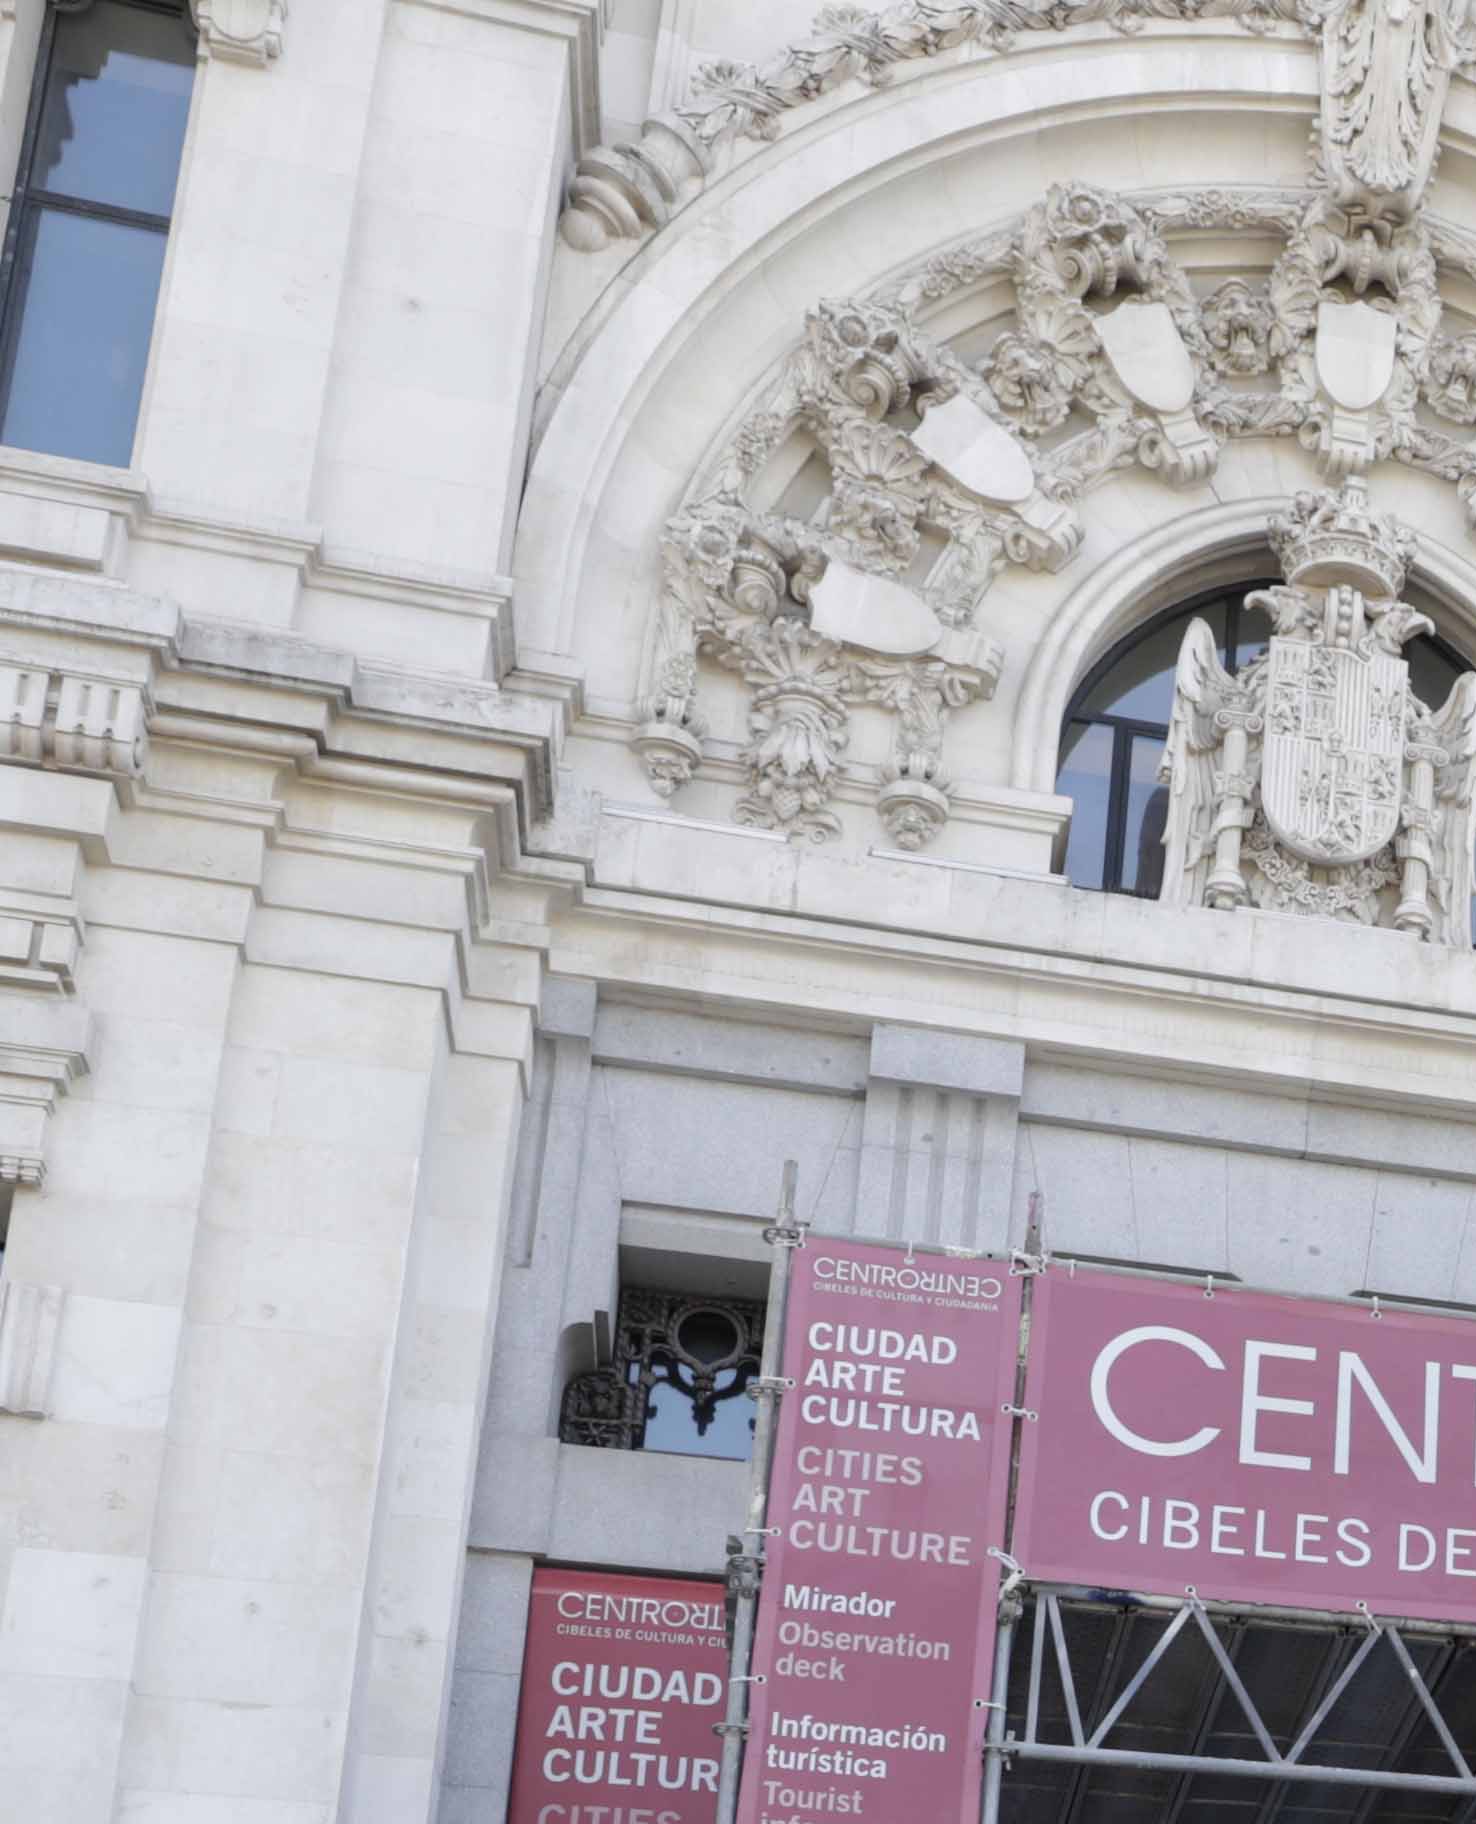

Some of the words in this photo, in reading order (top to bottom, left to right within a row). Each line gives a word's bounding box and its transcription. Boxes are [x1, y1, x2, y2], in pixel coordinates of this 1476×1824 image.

[808, 1322, 957, 1365] CIUDAD
[804, 1358, 906, 1396] ARTE
[801, 1395, 982, 1440] CULTURA
[796, 1446, 923, 1486] CITIES
[792, 1483, 871, 1517] ART
[788, 1519, 971, 1566] CULTURE
[1089, 1490, 1372, 1568] CIBELES
[783, 1584, 896, 1618] Mirador
[556, 1623, 612, 1639] CIBELES
[615, 1629, 633, 1640] DE
[634, 1629, 695, 1645] CULTURA
[778, 1621, 950, 1661] Observation
[551, 1661, 722, 1706] CIUDAD
[775, 1652, 846, 1681] deck
[546, 1705, 663, 1744] ARTE
[770, 1711, 946, 1752] Información
[542, 1748, 719, 1792] CULTUR
[766, 1743, 887, 1778] turística
[764, 1780, 863, 1814] Tourist
